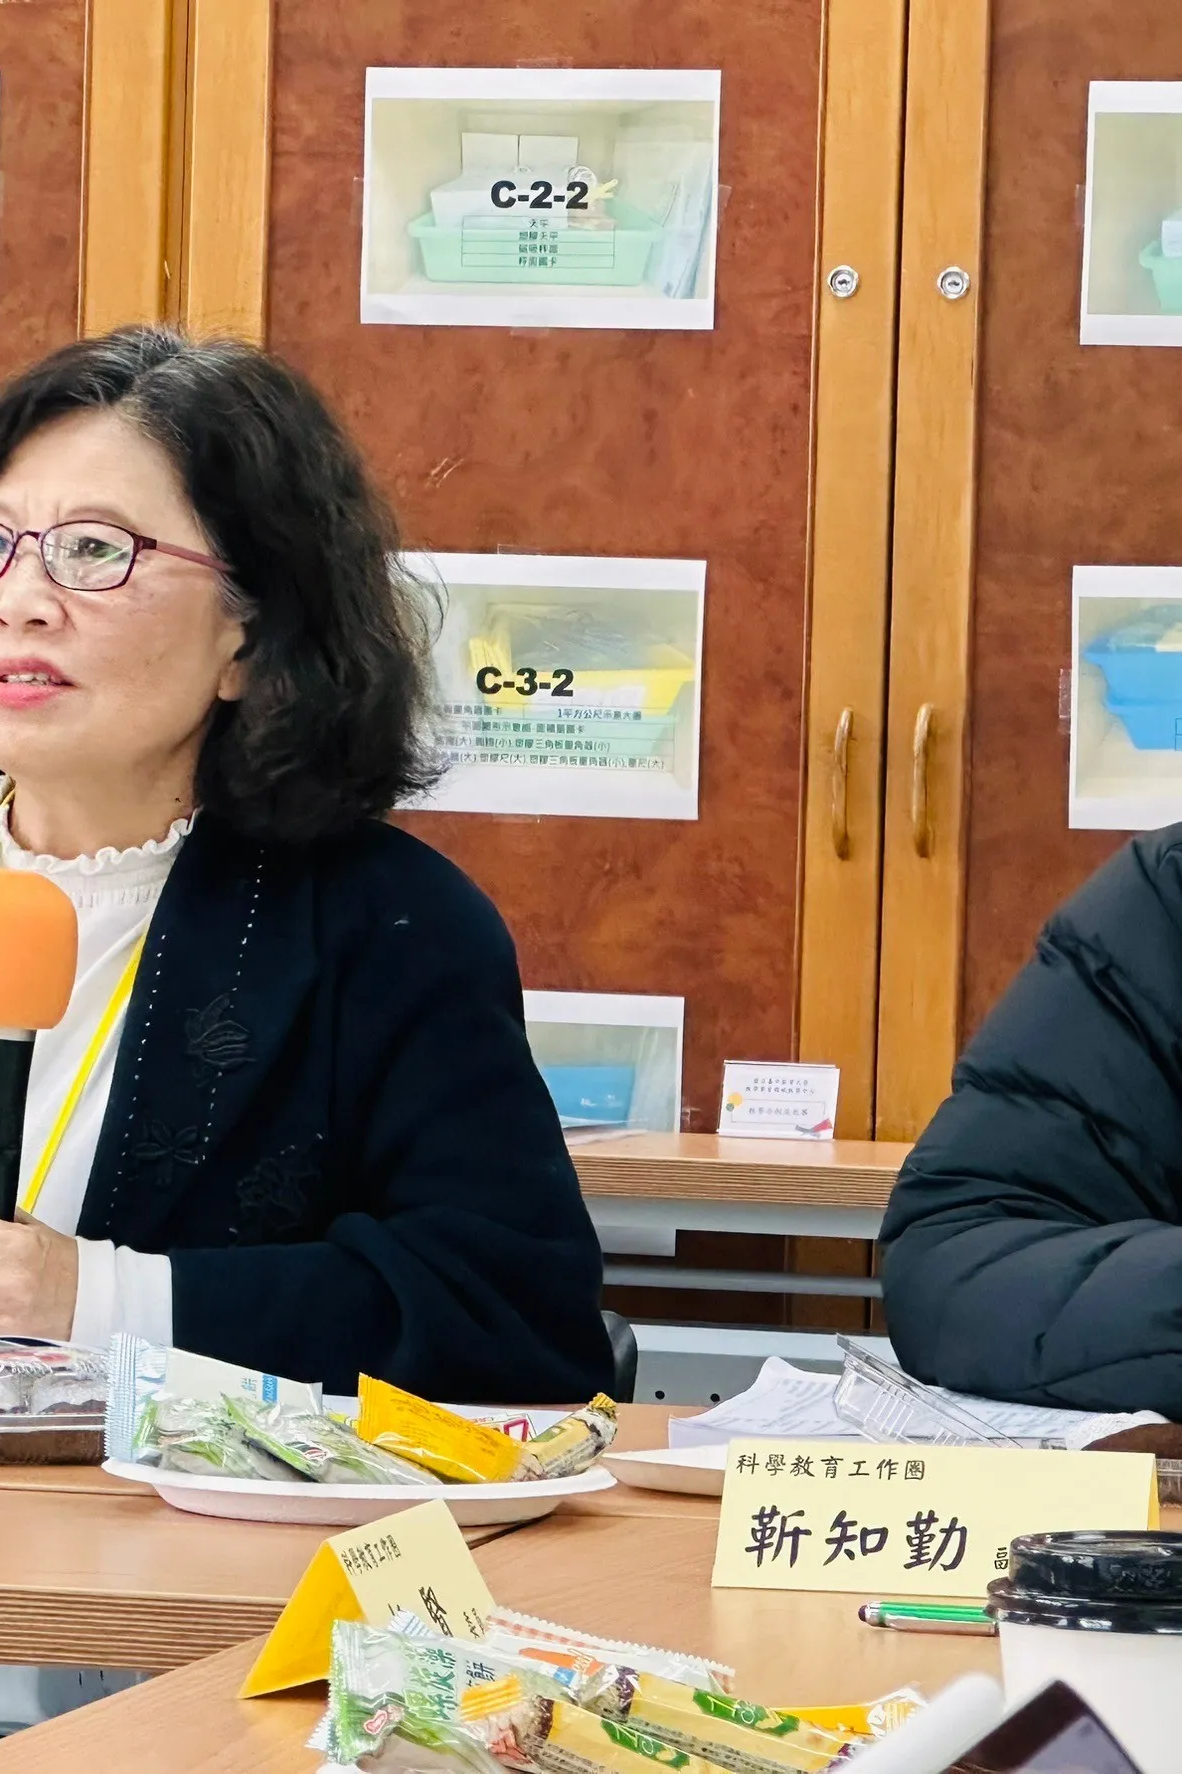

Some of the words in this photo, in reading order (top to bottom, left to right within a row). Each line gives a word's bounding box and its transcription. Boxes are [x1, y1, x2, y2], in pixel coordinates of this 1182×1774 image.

[490, 181, 589, 209] C-2-2
[476, 666, 574, 697] C-3-2
[736, 1453, 925, 1480] 科學教育工作圈
[745, 1505, 968, 1571] 靳知勤
